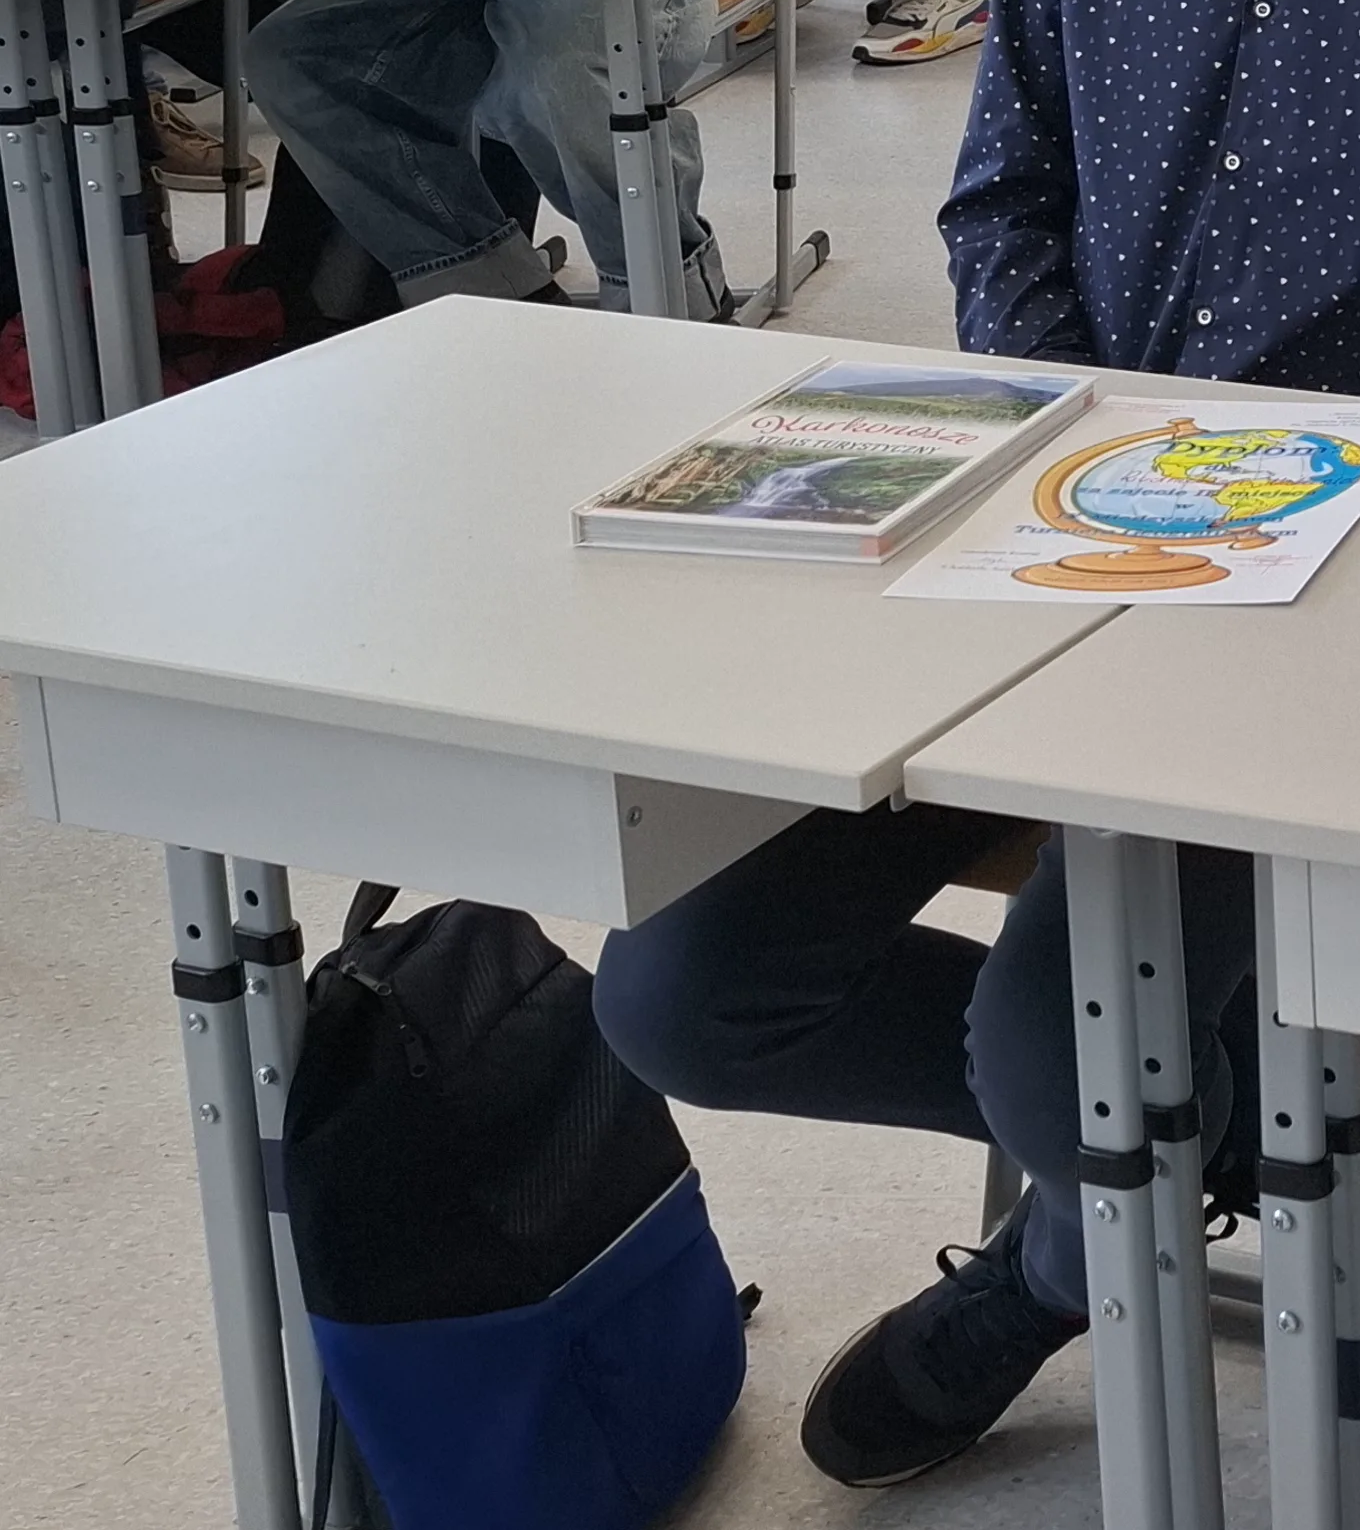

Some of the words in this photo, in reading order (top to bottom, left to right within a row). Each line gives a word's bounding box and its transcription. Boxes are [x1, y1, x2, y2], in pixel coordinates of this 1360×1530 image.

[751, 413, 980, 446] Karkonosze
[751, 435, 810, 448] ATLAS
[812, 438, 942, 456] TURYSTYCZNY
[1153, 441, 1332, 460] Dyplom
